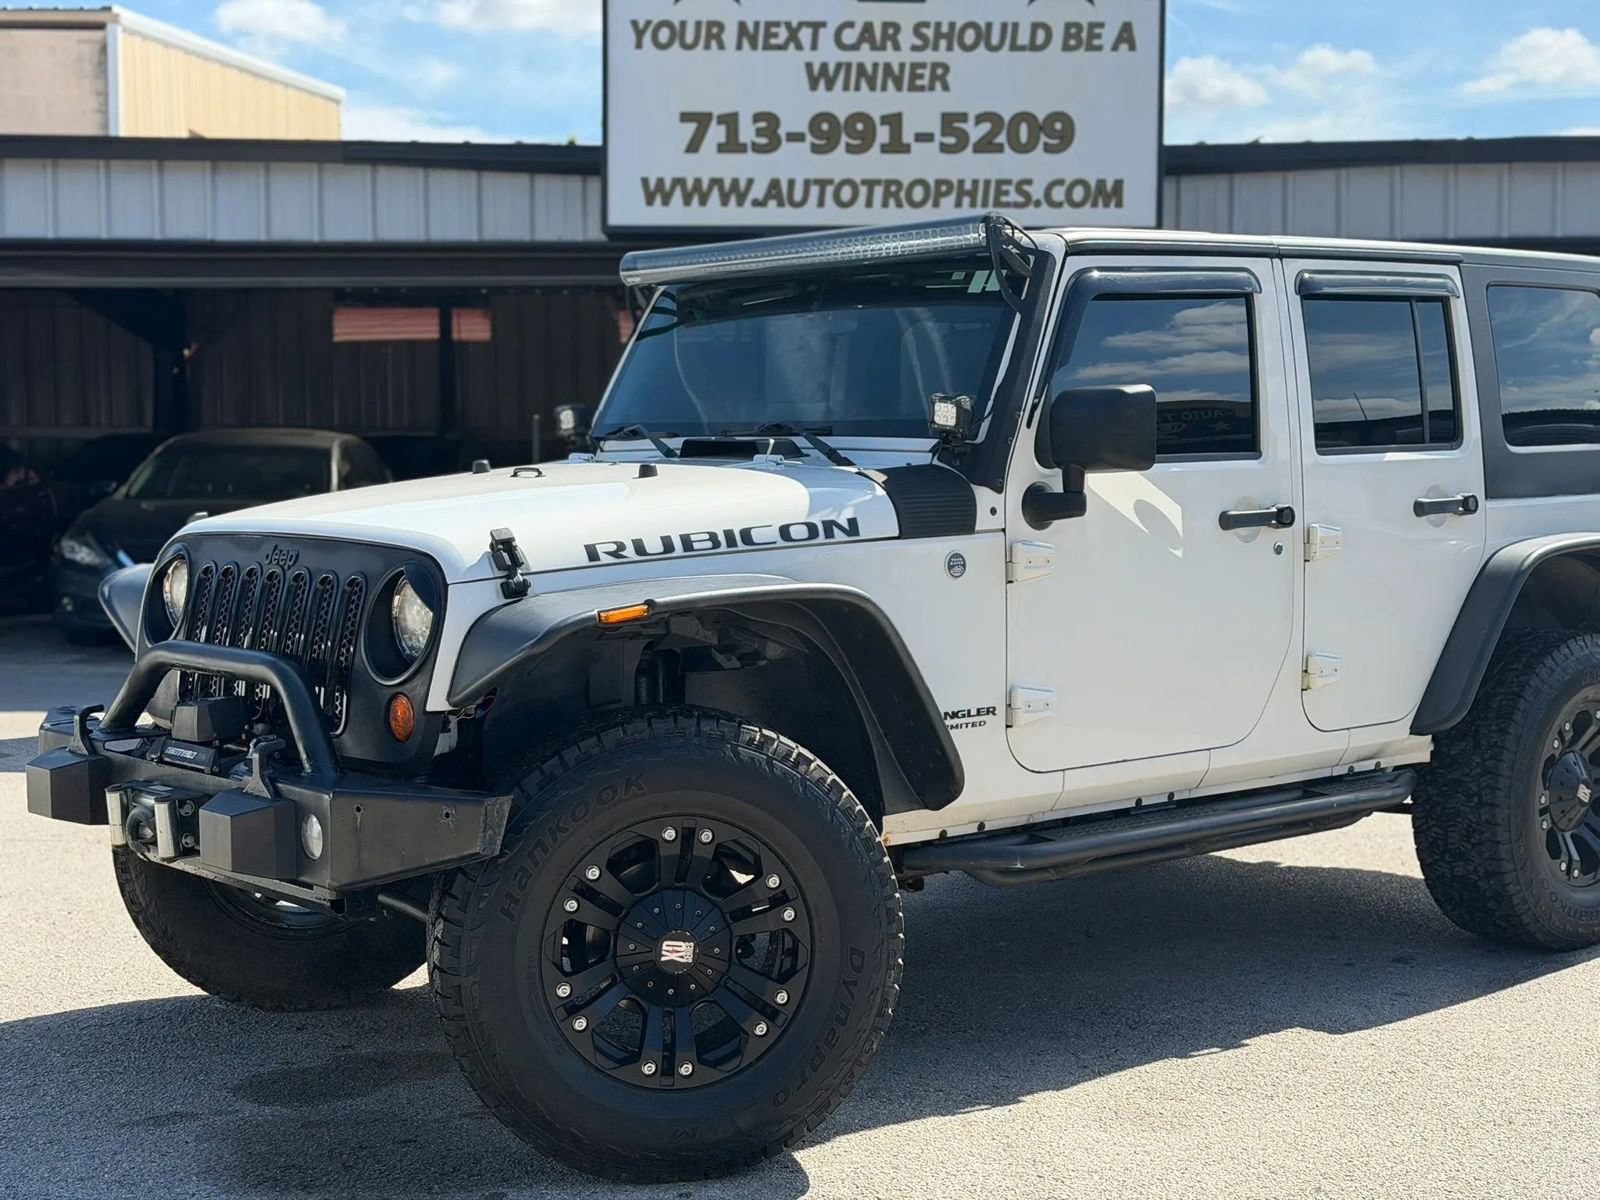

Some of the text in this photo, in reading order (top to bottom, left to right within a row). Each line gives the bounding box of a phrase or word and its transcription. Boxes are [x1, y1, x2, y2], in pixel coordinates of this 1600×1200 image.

[630, 19, 1137, 53] YOUR NEXT CAR SHOULD BE A
[804, 61, 951, 93] WINNER
[679, 110, 1076, 155] 713-991-5209
[640, 177, 1125, 209] WWW.AUTOTROPHIES.COM
[583, 517, 860, 563] RUBICON
[265, 544, 300, 570] Jeep
